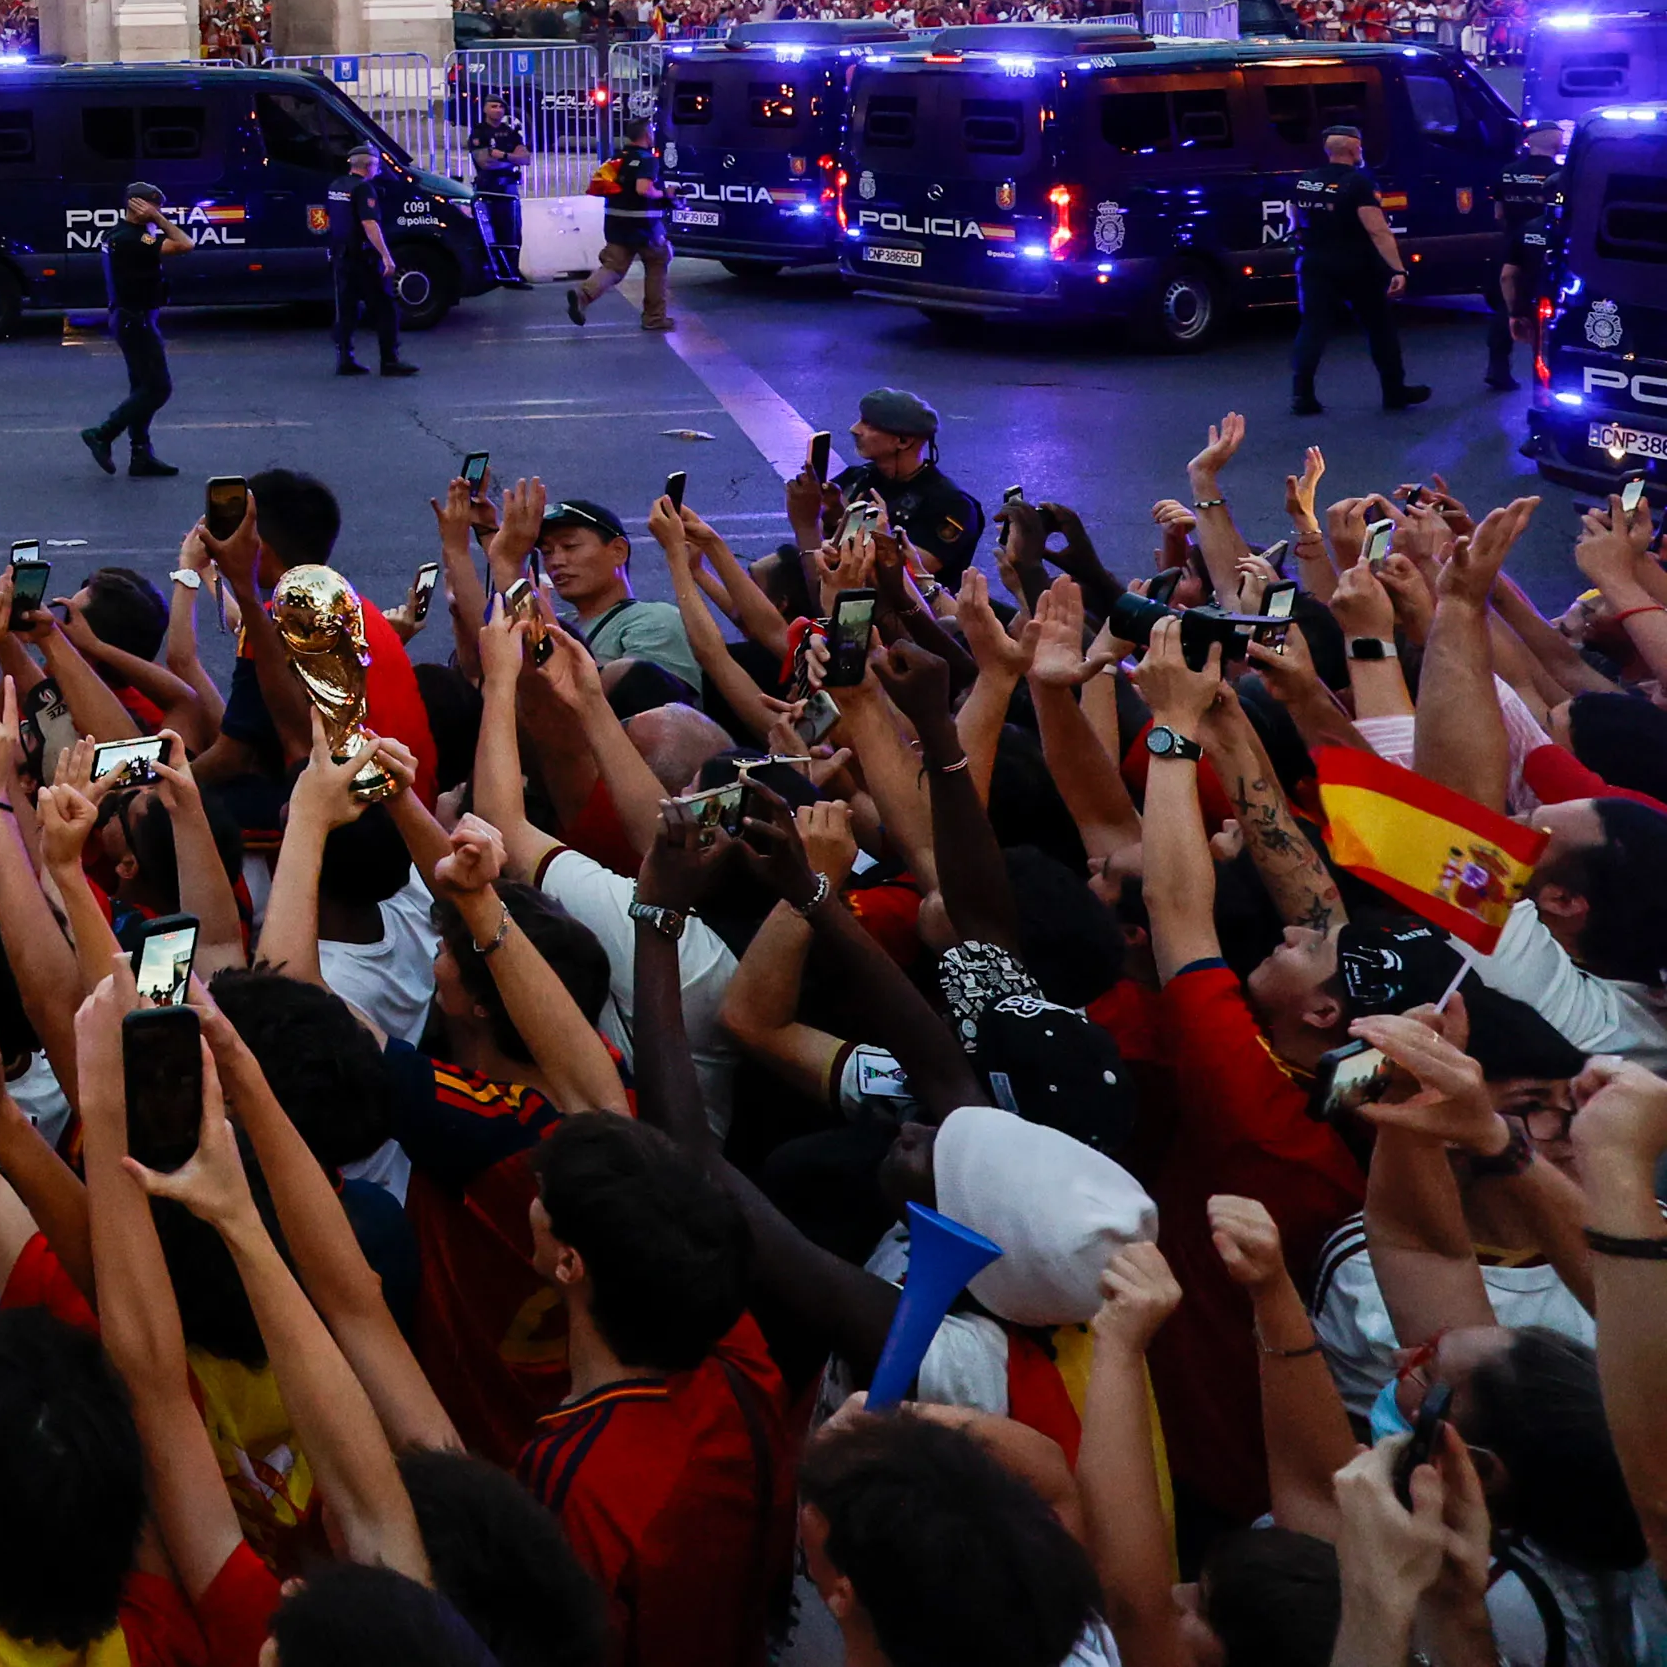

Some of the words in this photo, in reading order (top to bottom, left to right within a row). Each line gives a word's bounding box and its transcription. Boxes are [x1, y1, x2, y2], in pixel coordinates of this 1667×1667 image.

[66, 207, 199, 228] POCIA
[397, 215, 439, 226] @policia
[859, 209, 985, 240] POLICIA
